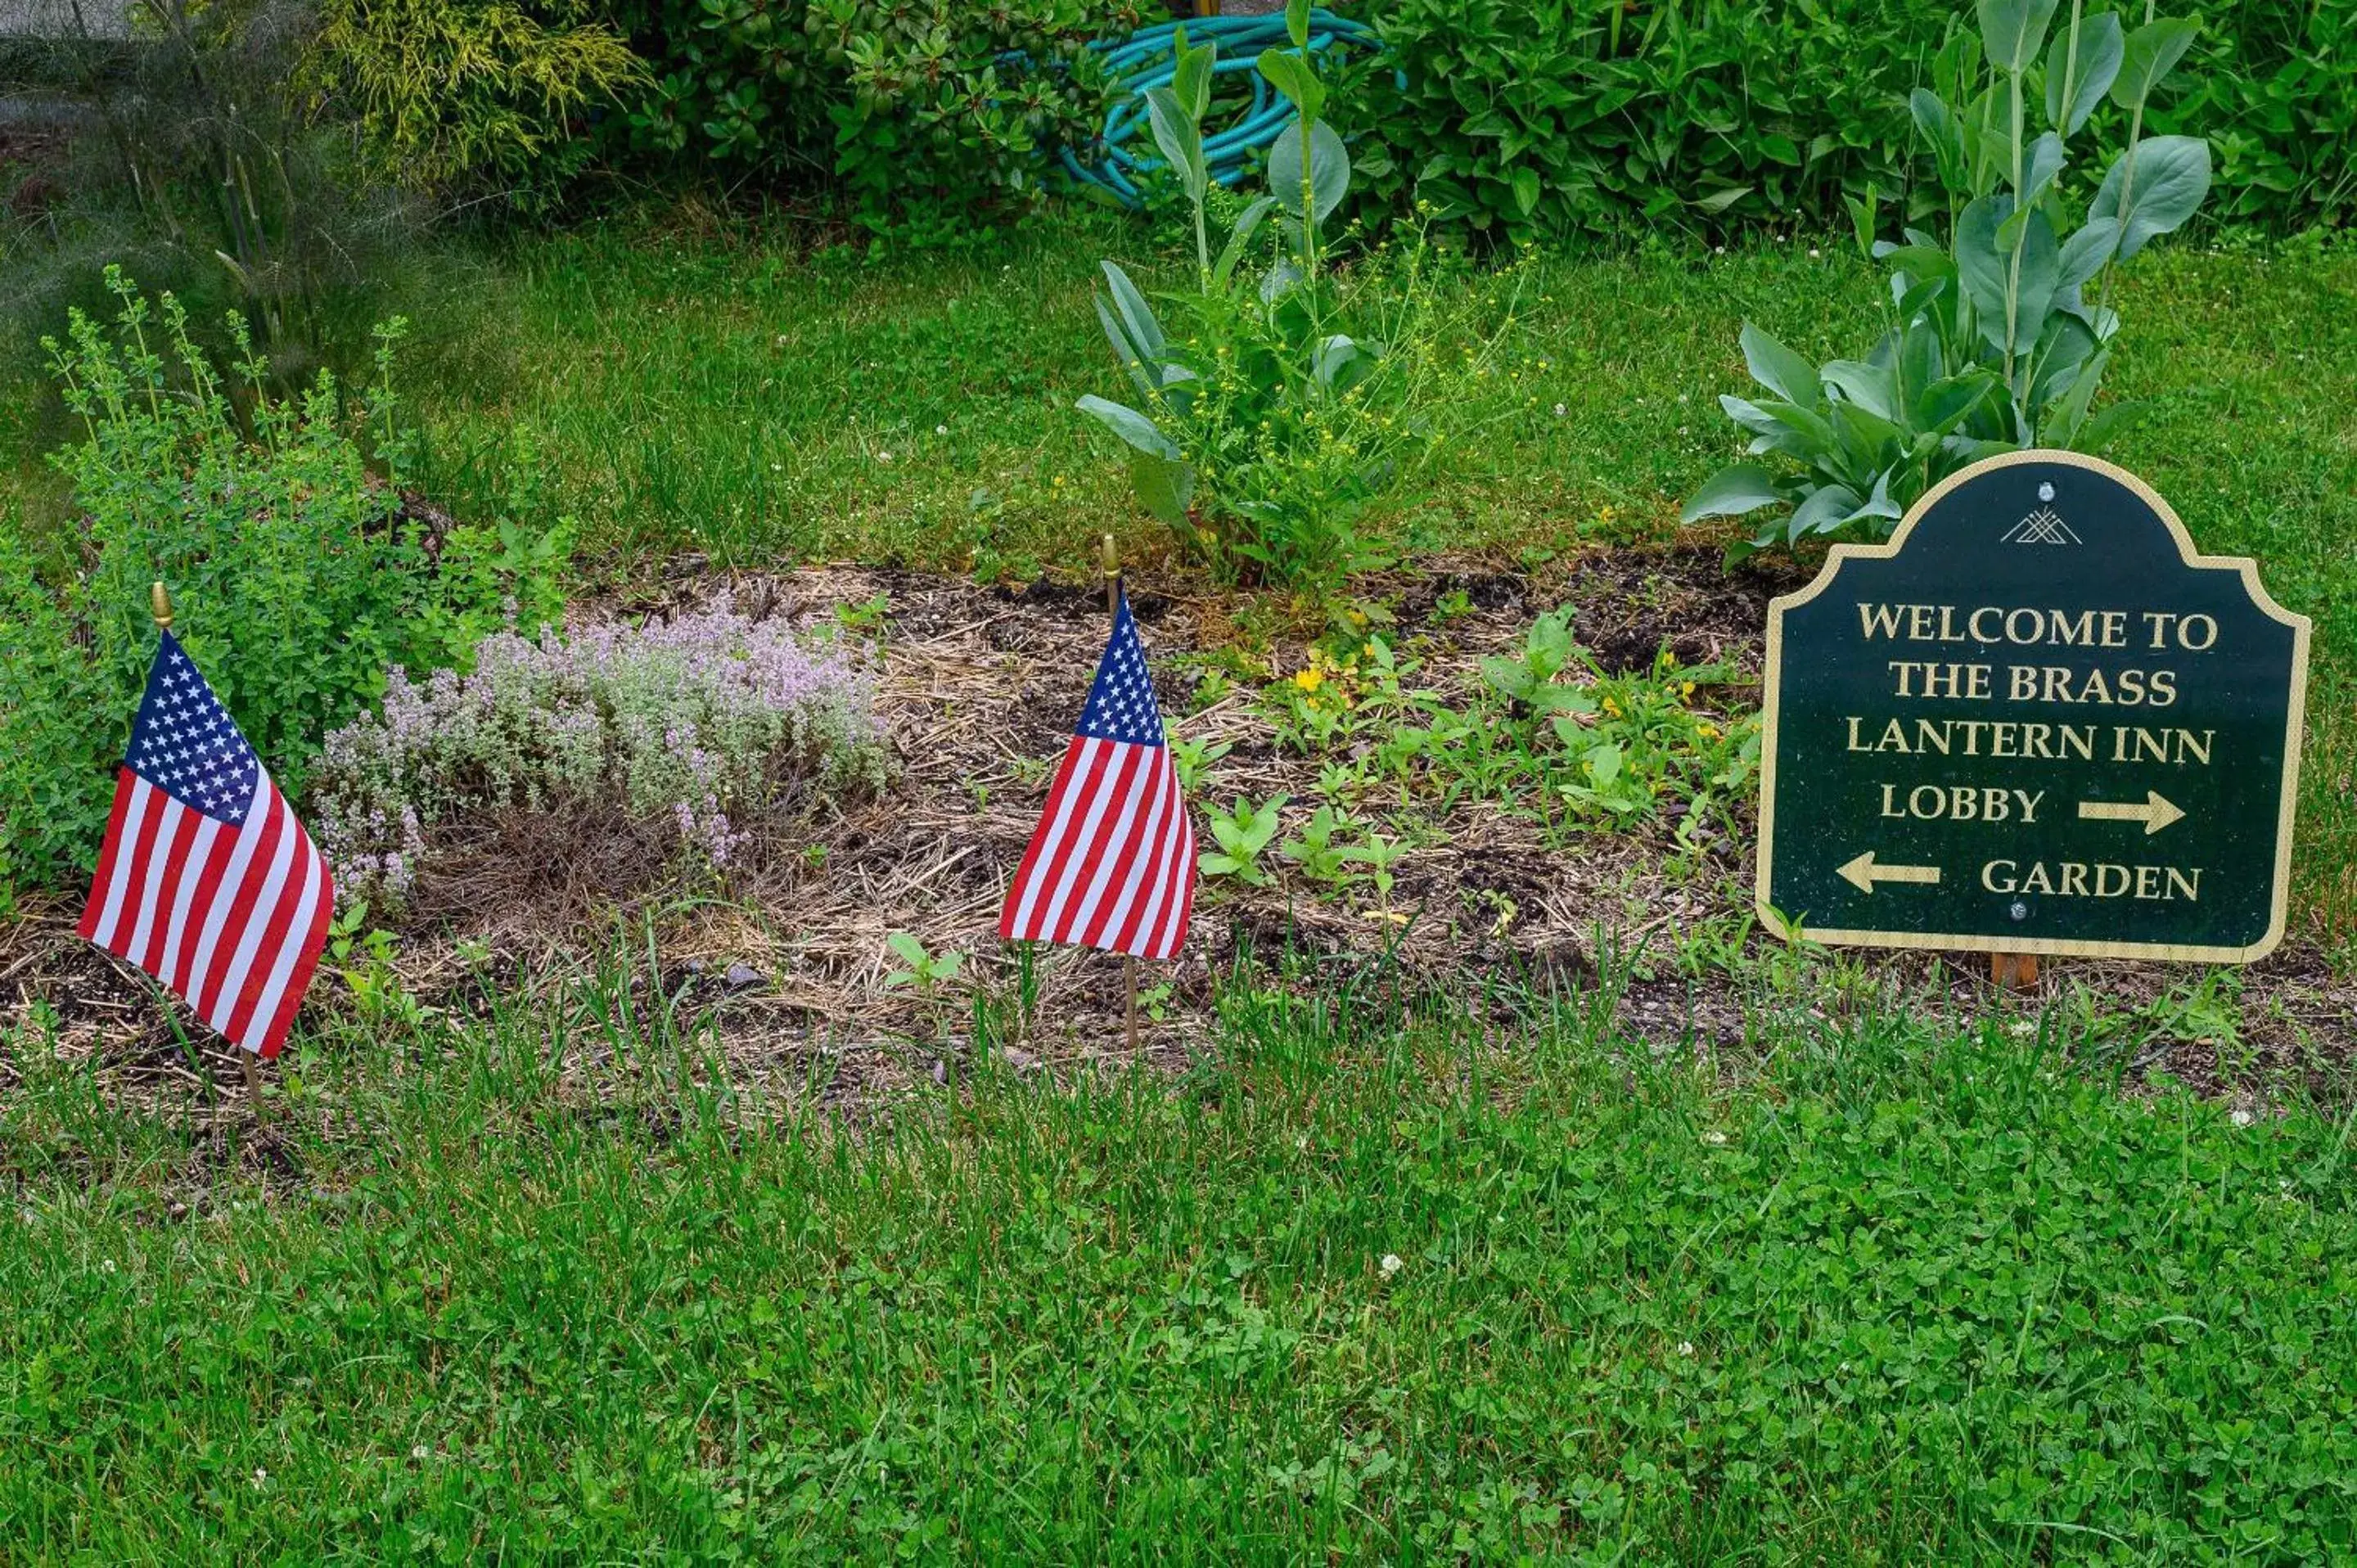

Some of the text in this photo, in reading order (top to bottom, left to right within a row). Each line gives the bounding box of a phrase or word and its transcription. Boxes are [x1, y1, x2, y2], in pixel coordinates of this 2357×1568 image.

[1857, 602, 2218, 650] WELCOME TO
[1888, 661, 2177, 706] THE BRASS
[1846, 717, 2216, 764] LANTERN INN
[1881, 784, 2045, 822] LOBBY
[1981, 859, 2203, 901] GARDEN
